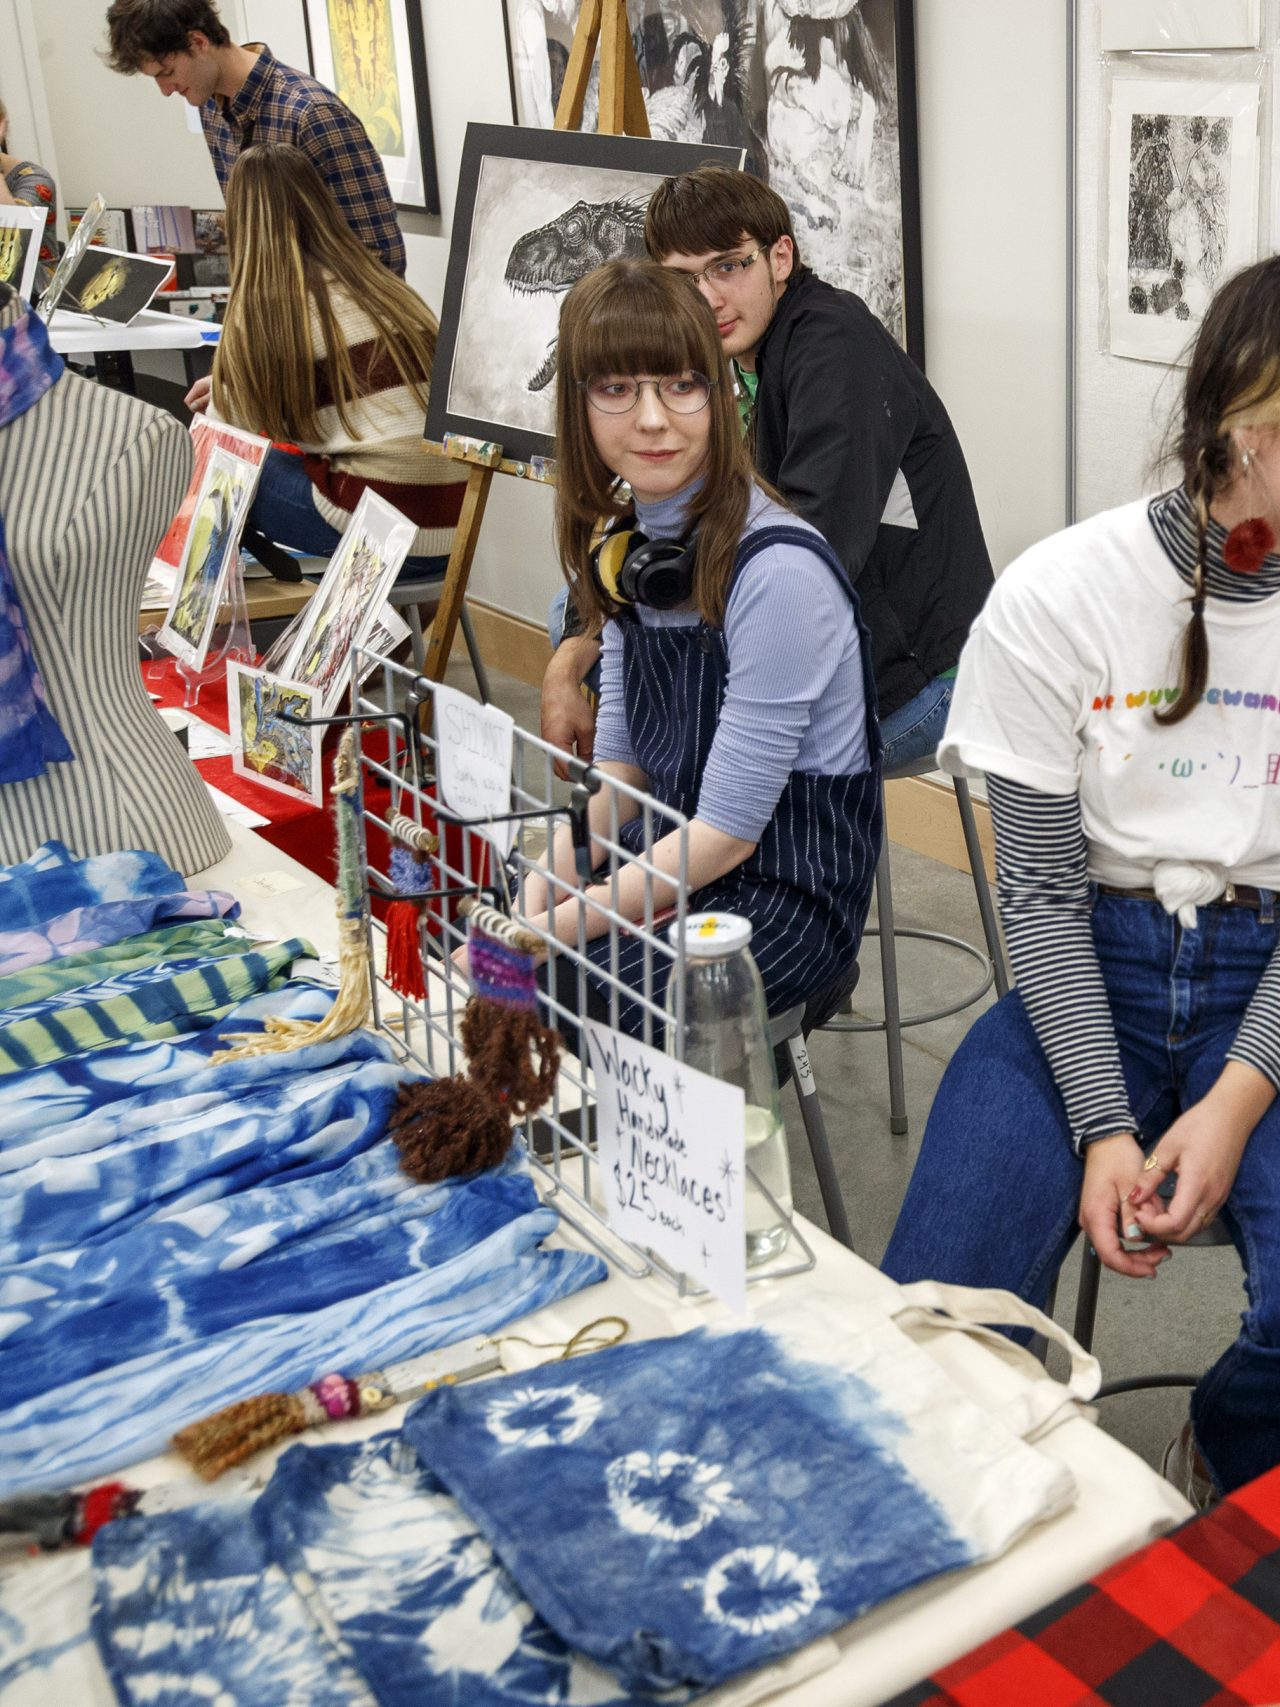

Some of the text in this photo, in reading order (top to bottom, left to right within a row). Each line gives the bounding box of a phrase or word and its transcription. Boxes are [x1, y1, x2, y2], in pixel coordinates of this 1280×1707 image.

[590, 1027, 669, 1134] Wacky
[617, 1088, 687, 1157] Handmade
[614, 1160, 685, 1236] $25 each
[631, 1134, 725, 1222] Necklaces
